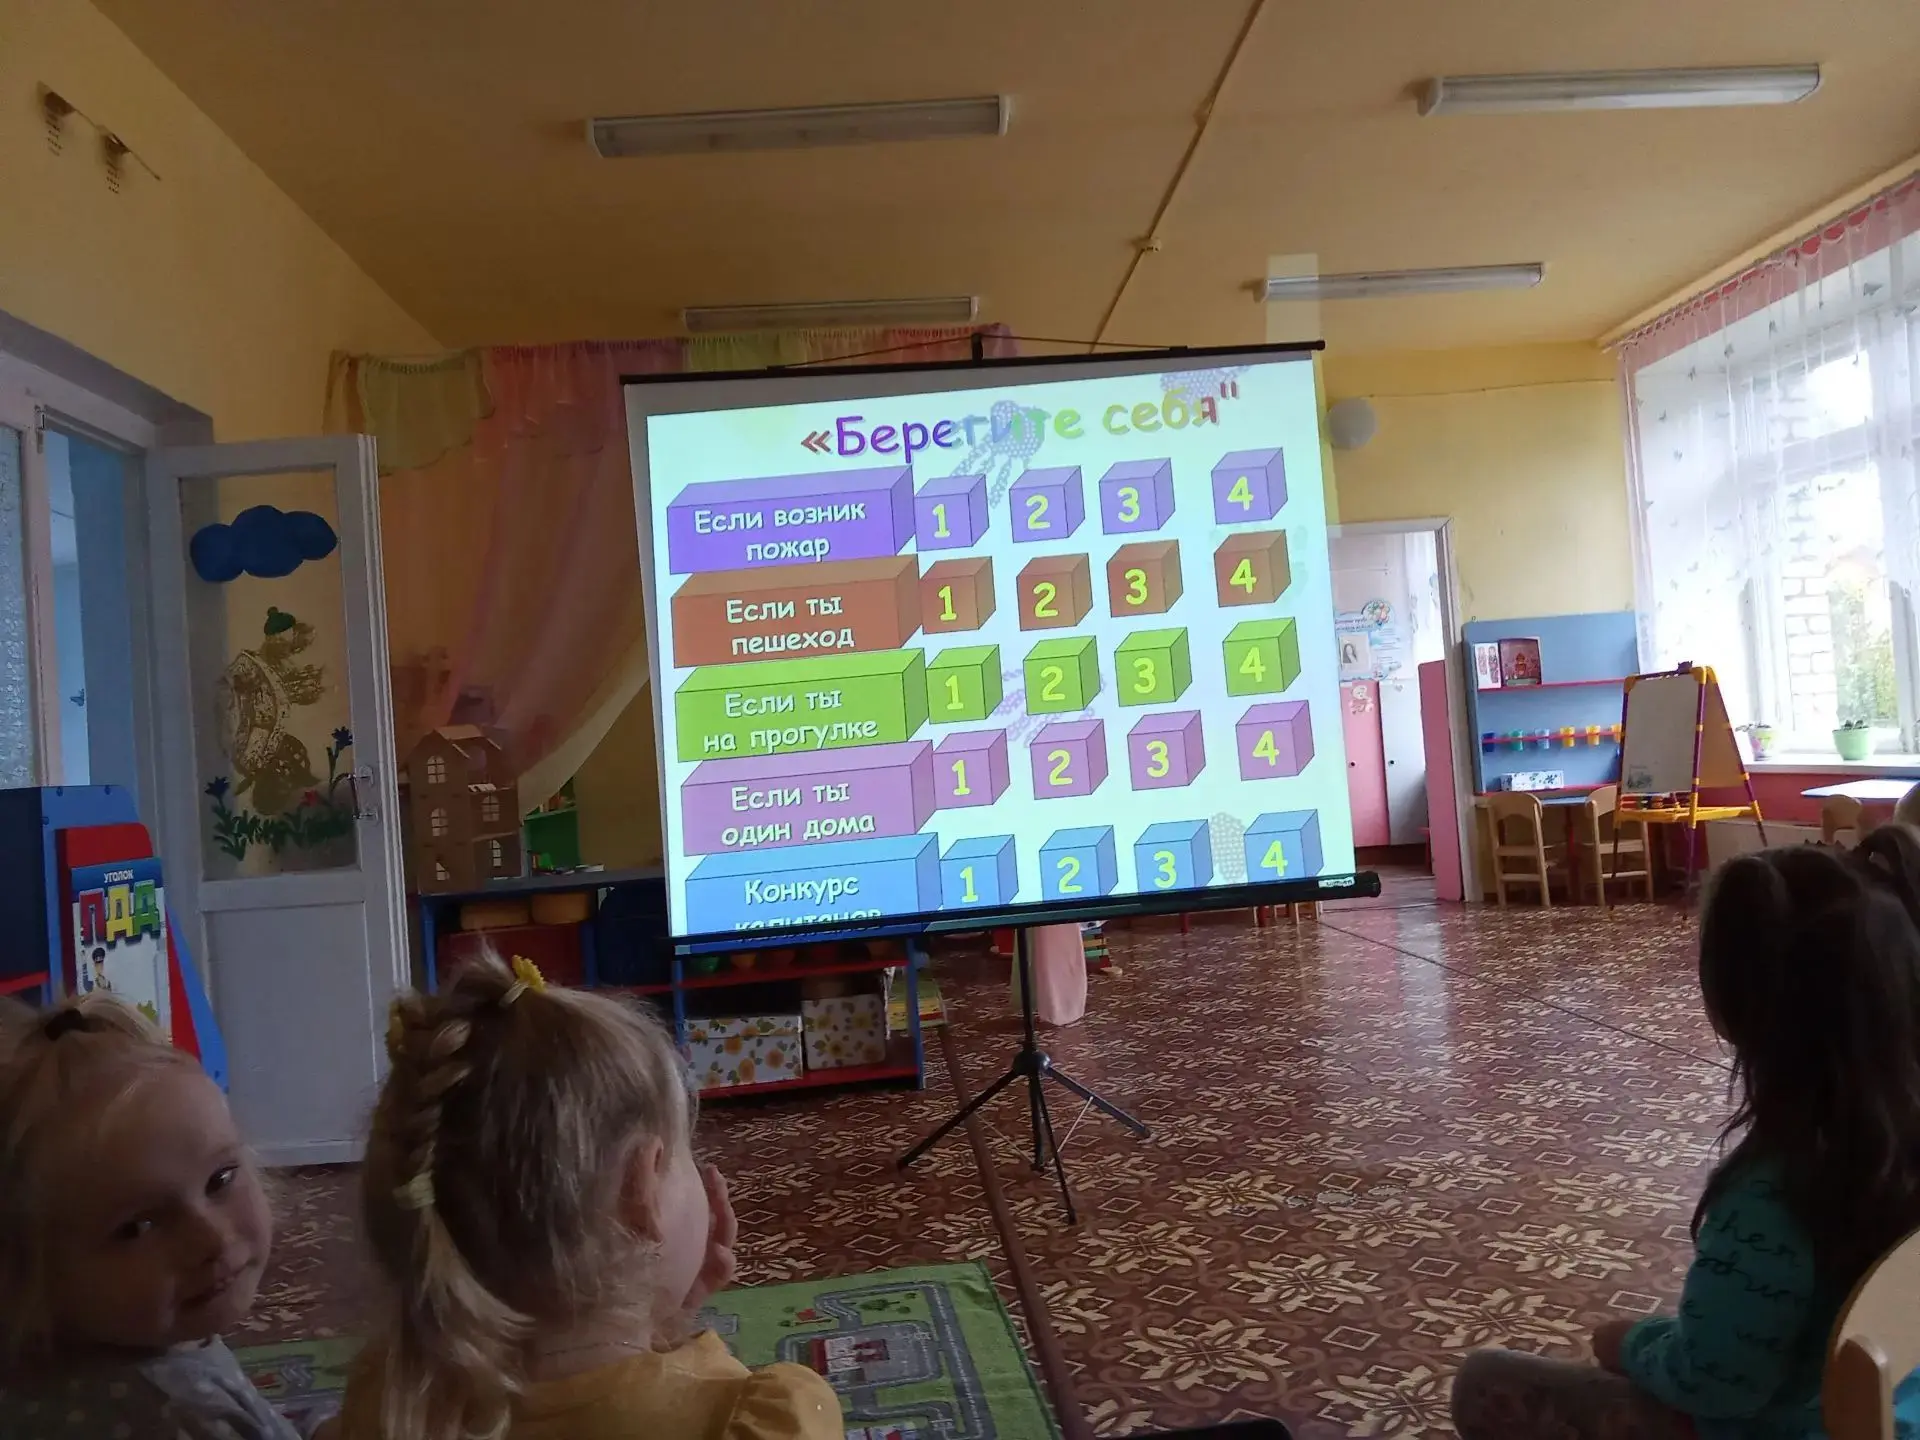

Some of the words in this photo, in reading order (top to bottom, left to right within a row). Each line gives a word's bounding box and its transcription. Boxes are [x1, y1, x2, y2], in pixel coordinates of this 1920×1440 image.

[801, 406, 1085, 463] «Берегите
[1117, 487, 1141, 523] 3
[1227, 476, 1254, 511] 4
[694, 509, 763, 534] Если
[774, 502, 867, 526] возник
[932, 503, 951, 539] 1
[1026, 495, 1051, 530] 2
[746, 537, 831, 562] пожар
[1124, 568, 1148, 605] 3
[1229, 558, 1257, 594] 4
[726, 599, 795, 624] Если
[805, 596, 843, 617] ты
[937, 585, 957, 621] 1
[1033, 582, 1059, 618] 2
[731, 627, 855, 656] пешеход
[1132, 657, 1157, 694] 3
[1239, 646, 1266, 683] 4
[945, 674, 964, 710] 1
[1040, 665, 1065, 702] 2
[725, 692, 795, 718] Если
[804, 689, 842, 710] ты
[703, 732, 737, 754] на
[750, 719, 878, 754] прогулке
[1252, 730, 1280, 767] 4
[1047, 749, 1073, 786] 2
[1146, 740, 1170, 777] 3
[951, 759, 972, 796] 1
[731, 785, 801, 812] Если
[812, 782, 850, 804] ты
[721, 820, 792, 848] один
[802, 813, 875, 841] дома
[1056, 856, 1083, 893] 2
[1153, 850, 1177, 888] 3
[1260, 840, 1288, 877] 4
[744, 874, 860, 906] Конкурс
[959, 866, 979, 903] 1
[79, 879, 160, 943] ПДД
